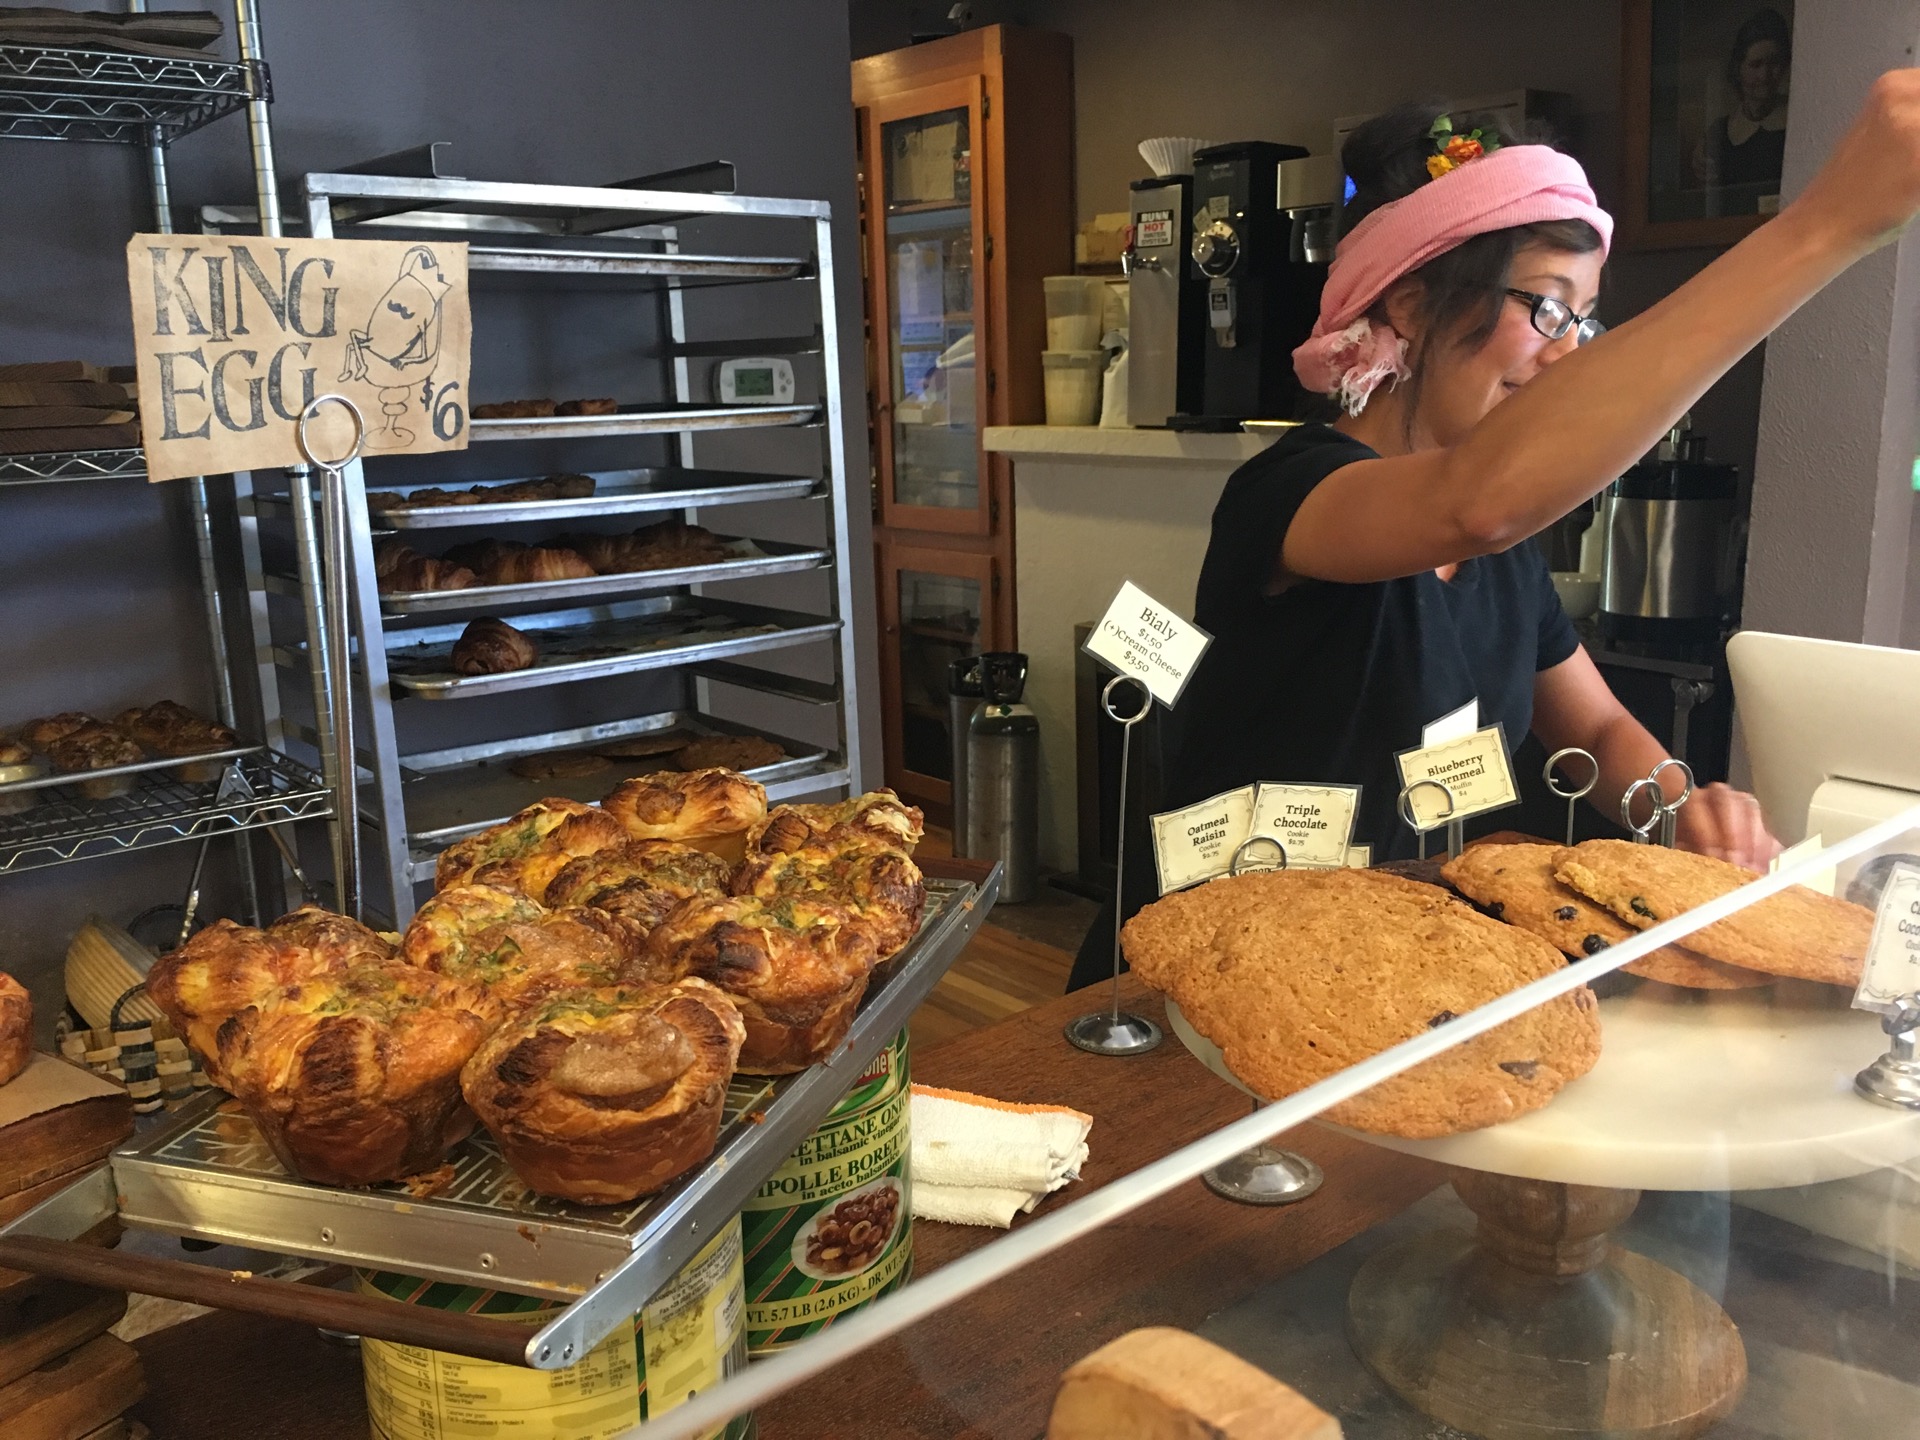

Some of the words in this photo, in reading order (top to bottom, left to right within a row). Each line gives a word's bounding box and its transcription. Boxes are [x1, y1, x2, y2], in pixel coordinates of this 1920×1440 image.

[1141, 211, 1169, 222] BUNN
[1144, 222, 1165, 232] HOT
[147, 245, 339, 342] KING
[154, 342, 320, 440] EGG
[419, 375, 464, 441] $6
[1139, 607, 1178, 641] Bialy
[1138, 628, 1162, 649] $1.50
[1124, 651, 1149, 673] $3.50
[1149, 651, 1182, 679] Cheese
[1427, 754, 1484, 777] Blueberry
[1450, 781, 1473, 791] Muffin
[1286, 805, 1320, 818] Triple
[1188, 814, 1230, 837] Oatmeal
[1274, 817, 1328, 830] Chocolate
[1287, 830, 1309, 838] Cookie
[1193, 830, 1226, 847] Raisin
[1199, 841, 1222, 853] Cookie
[800, 1156, 813, 1166] in
[817, 1137, 870, 1162] balsamic
[872, 1115, 901, 1141] vinegar
[802, 1191, 815, 1200] in
[820, 1178, 853, 1196] aceto
[857, 1149, 900, 1183] balsamico
[771, 1307, 788, 1321] 5.7
[793, 1303, 811, 1318] LB
[815, 1297, 835, 1315] (2.6
[838, 1285, 860, 1305] KG)
[868, 1271, 884, 1289] DR.
